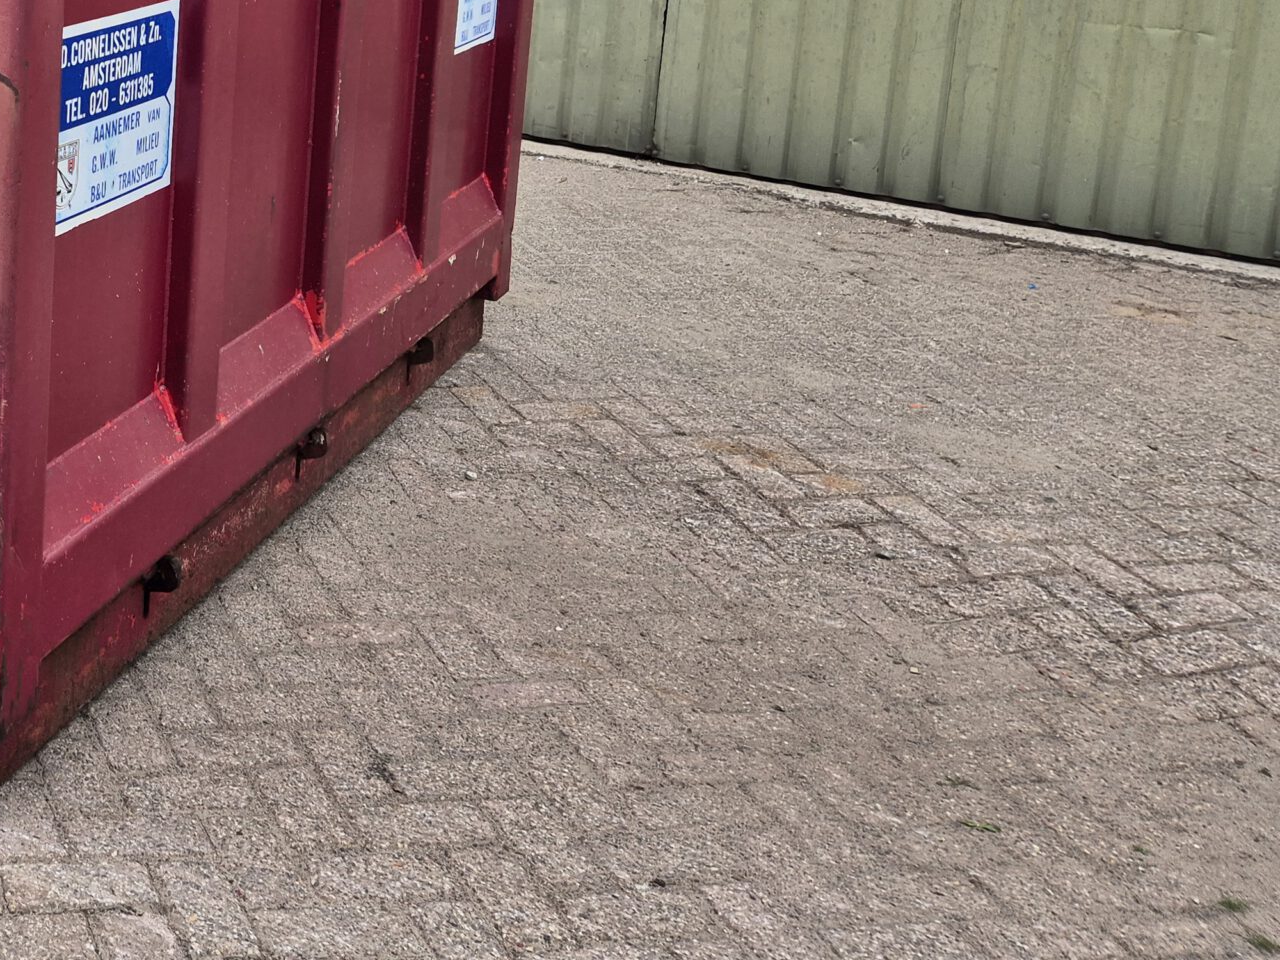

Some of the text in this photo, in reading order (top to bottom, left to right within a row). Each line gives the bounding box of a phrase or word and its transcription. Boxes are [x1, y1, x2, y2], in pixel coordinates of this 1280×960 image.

[140, 23, 147, 46] &
[148, 21, 162, 43] Zn.
[82, 51, 142, 90] AMSTERDAM
[65, 96, 86, 123] TEL.
[89, 87, 109, 115] 020
[119, 73, 154, 105] 6311385
[93, 107, 160, 144] AANNEMER VAN
[91, 149, 118, 173] G.W.W.
[135, 131, 160, 155] MILIEU
[90, 159, 158, 203] B&U TRANSPORT
